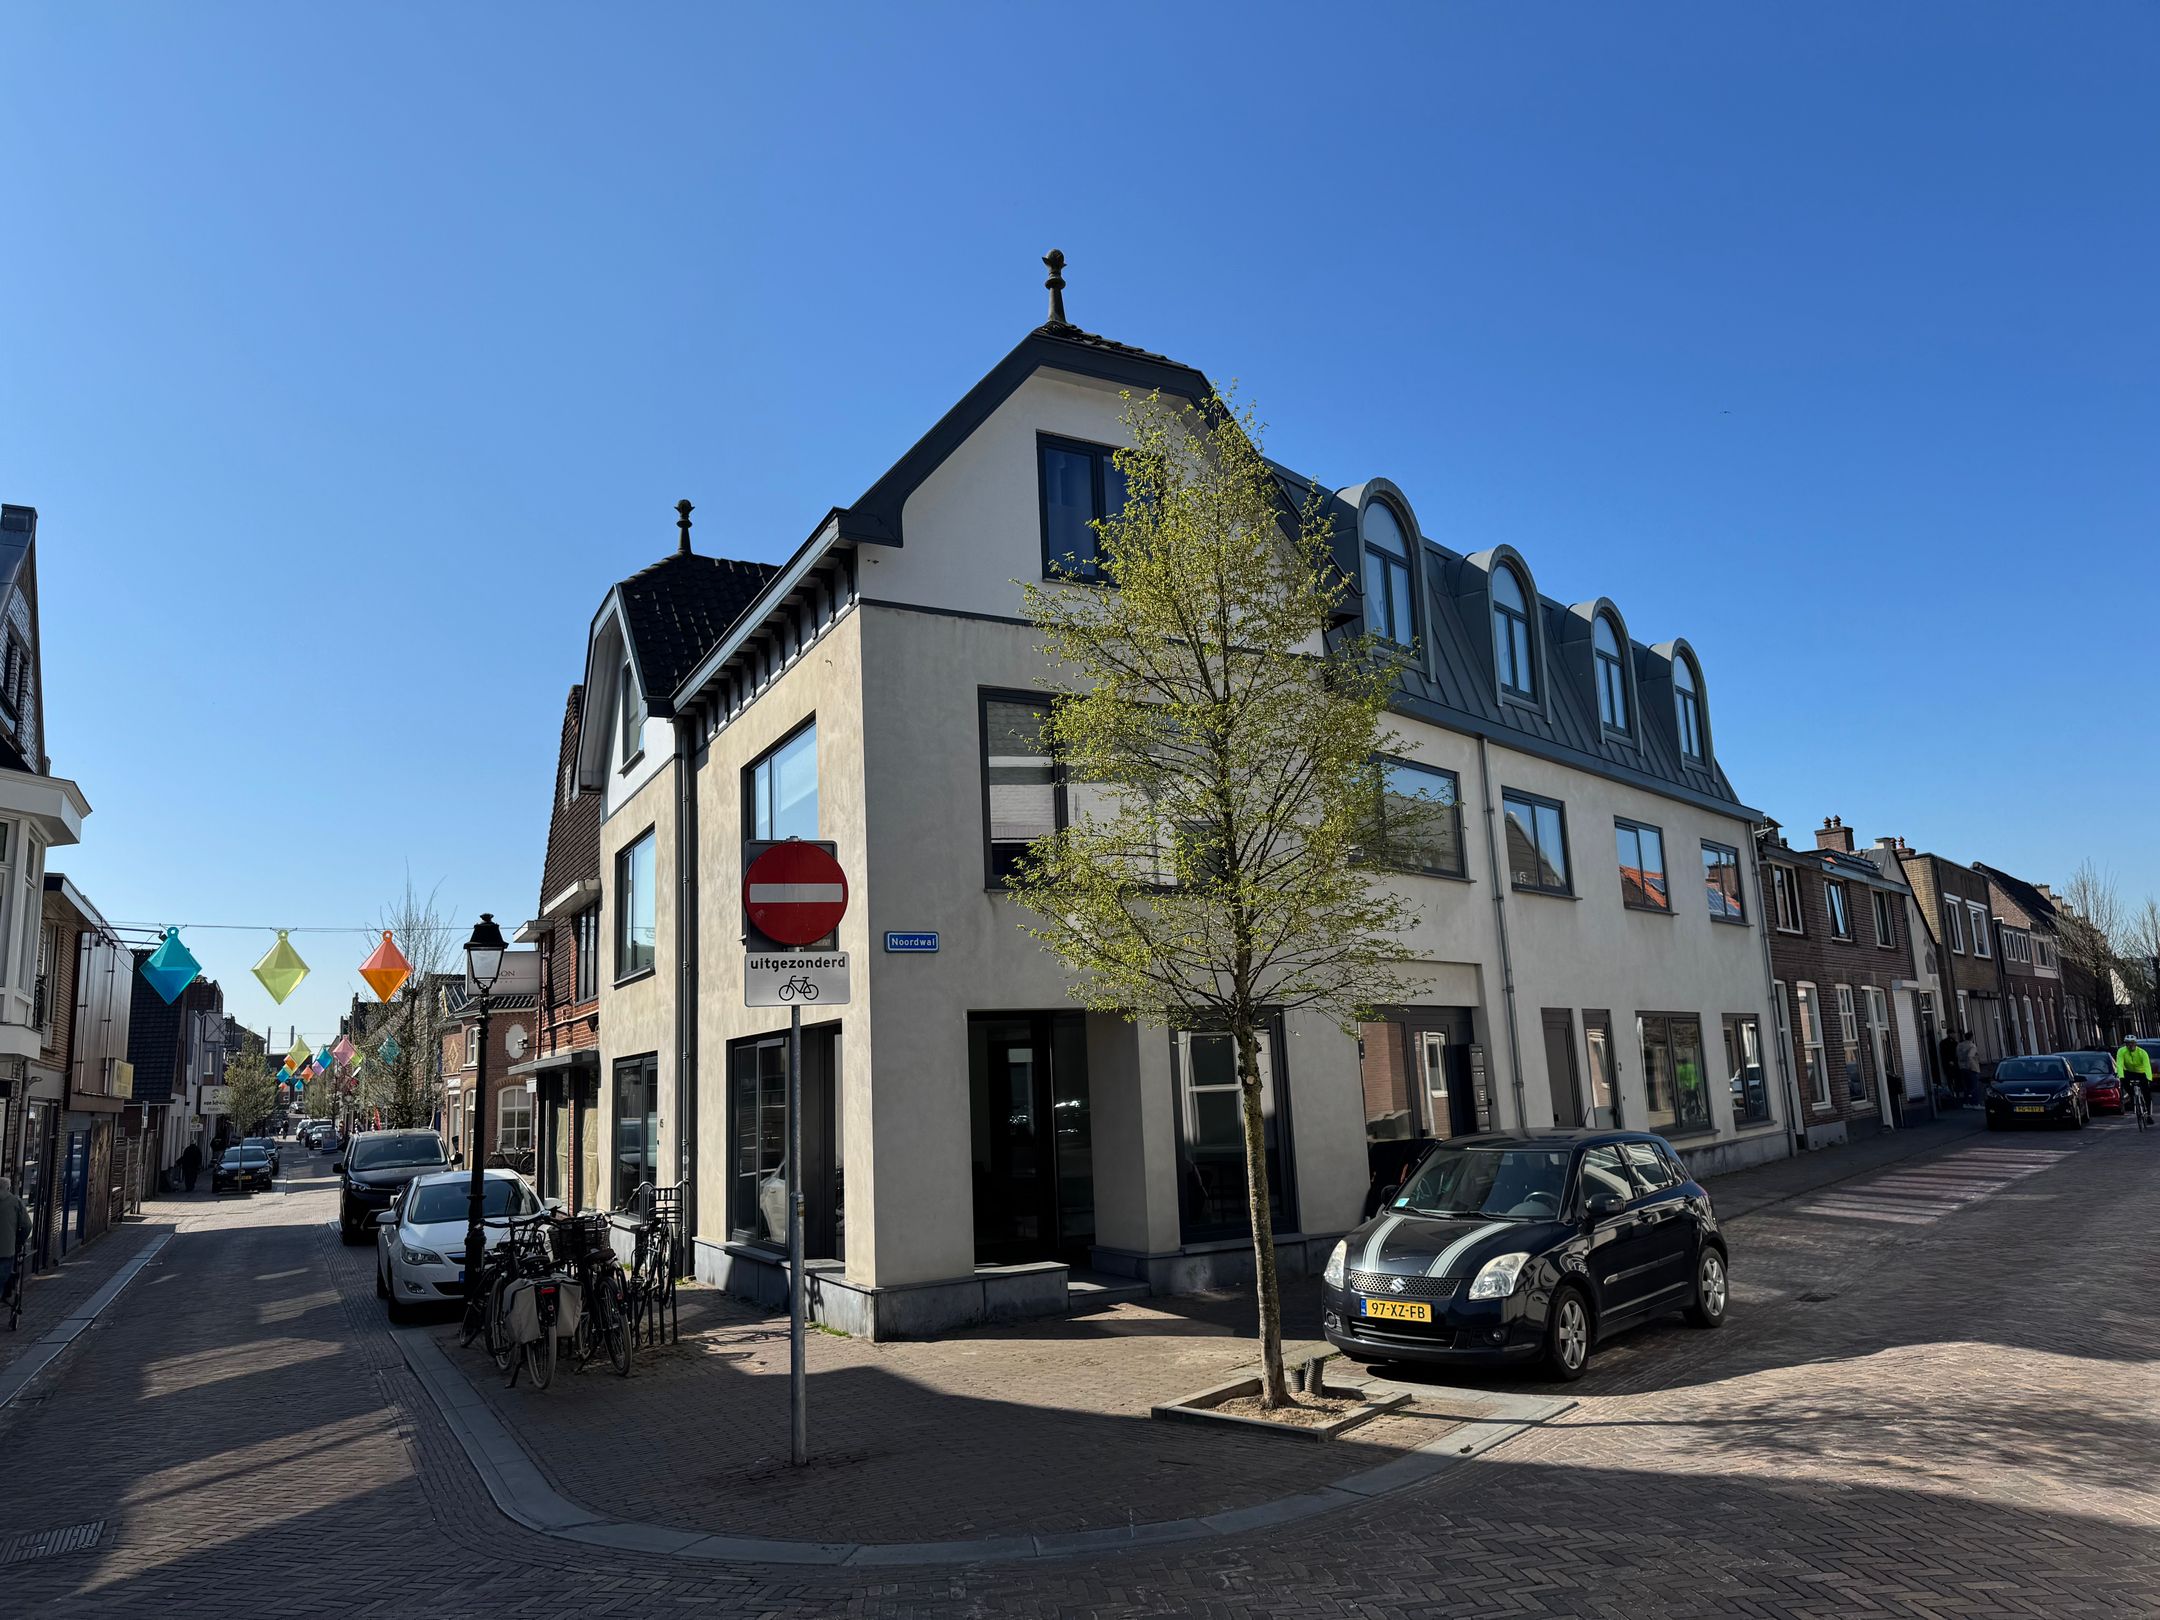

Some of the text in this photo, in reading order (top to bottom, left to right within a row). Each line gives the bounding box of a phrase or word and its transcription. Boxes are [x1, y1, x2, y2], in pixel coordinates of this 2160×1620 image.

[891, 937, 935, 946] Noordwal
[750, 956, 846, 972] uitgezonderd
[1371, 1302, 1425, 1319] 97-XZ-FB
